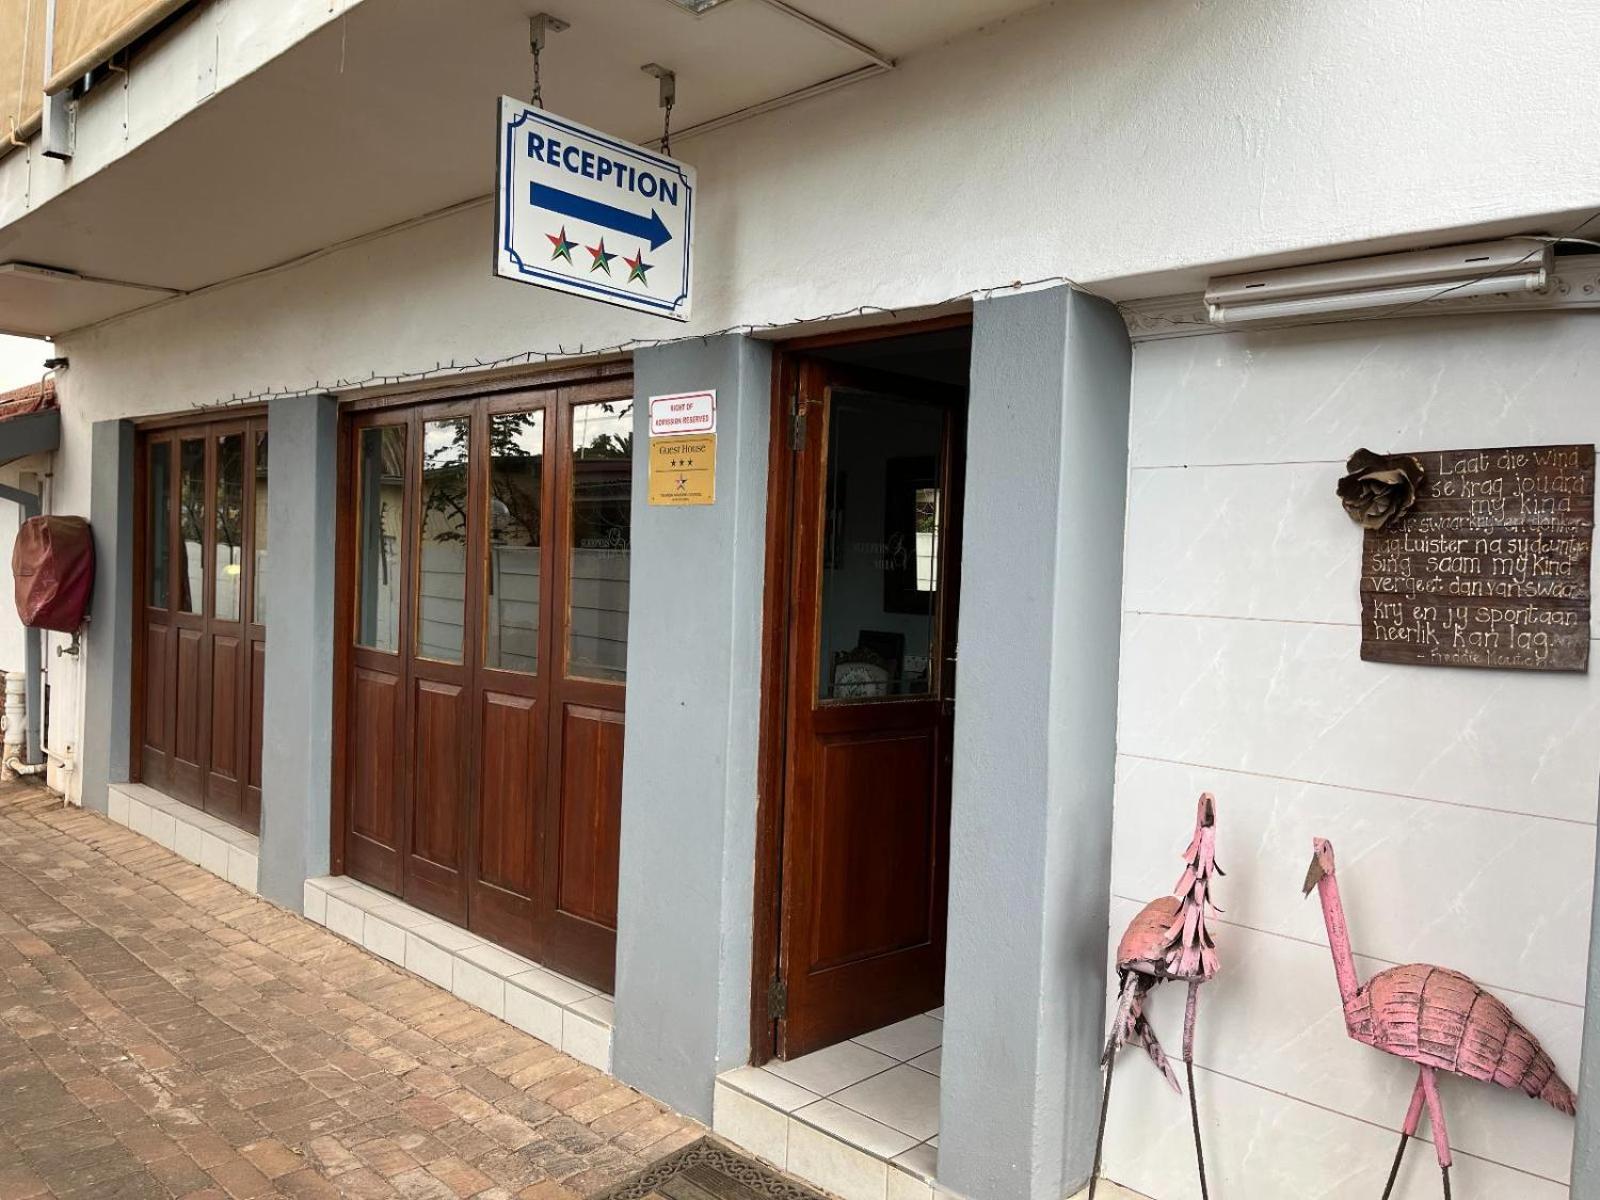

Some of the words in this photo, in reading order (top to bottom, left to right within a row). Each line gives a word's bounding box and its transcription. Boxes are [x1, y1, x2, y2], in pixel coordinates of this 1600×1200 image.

[527, 131, 678, 206] RECEPTION
[655, 417, 681, 426] ADMISSION
[683, 414, 709, 424] RESERVED
[670, 403, 685, 412] RIGHT
[686, 402, 694, 410] OF
[1439, 452, 1490, 476] Laat
[1497, 450, 1529, 470] die
[1532, 446, 1580, 468] wind
[1431, 480, 1455, 498] se
[1460, 474, 1504, 500] krag
[1512, 472, 1548, 497] jou
[1552, 468, 1585, 494] dra
[1470, 497, 1506, 523] my
[1519, 492, 1571, 515] kind
[1404, 533, 1468, 554] Luister
[1474, 538, 1503, 555] na
[1507, 538, 1529, 562] sy
[1425, 556, 1481, 573] saam
[1492, 554, 1529, 584] my
[1370, 576, 1444, 600] vergeet
[1449, 576, 1482, 597] dan
[1486, 581, 1521, 598] van
[1412, 606, 1437, 622] en
[1442, 607, 1468, 630] jy
[1475, 604, 1578, 630] spontaan
[1374, 620, 1440, 645] heerlik
[1452, 623, 1499, 648] kan
